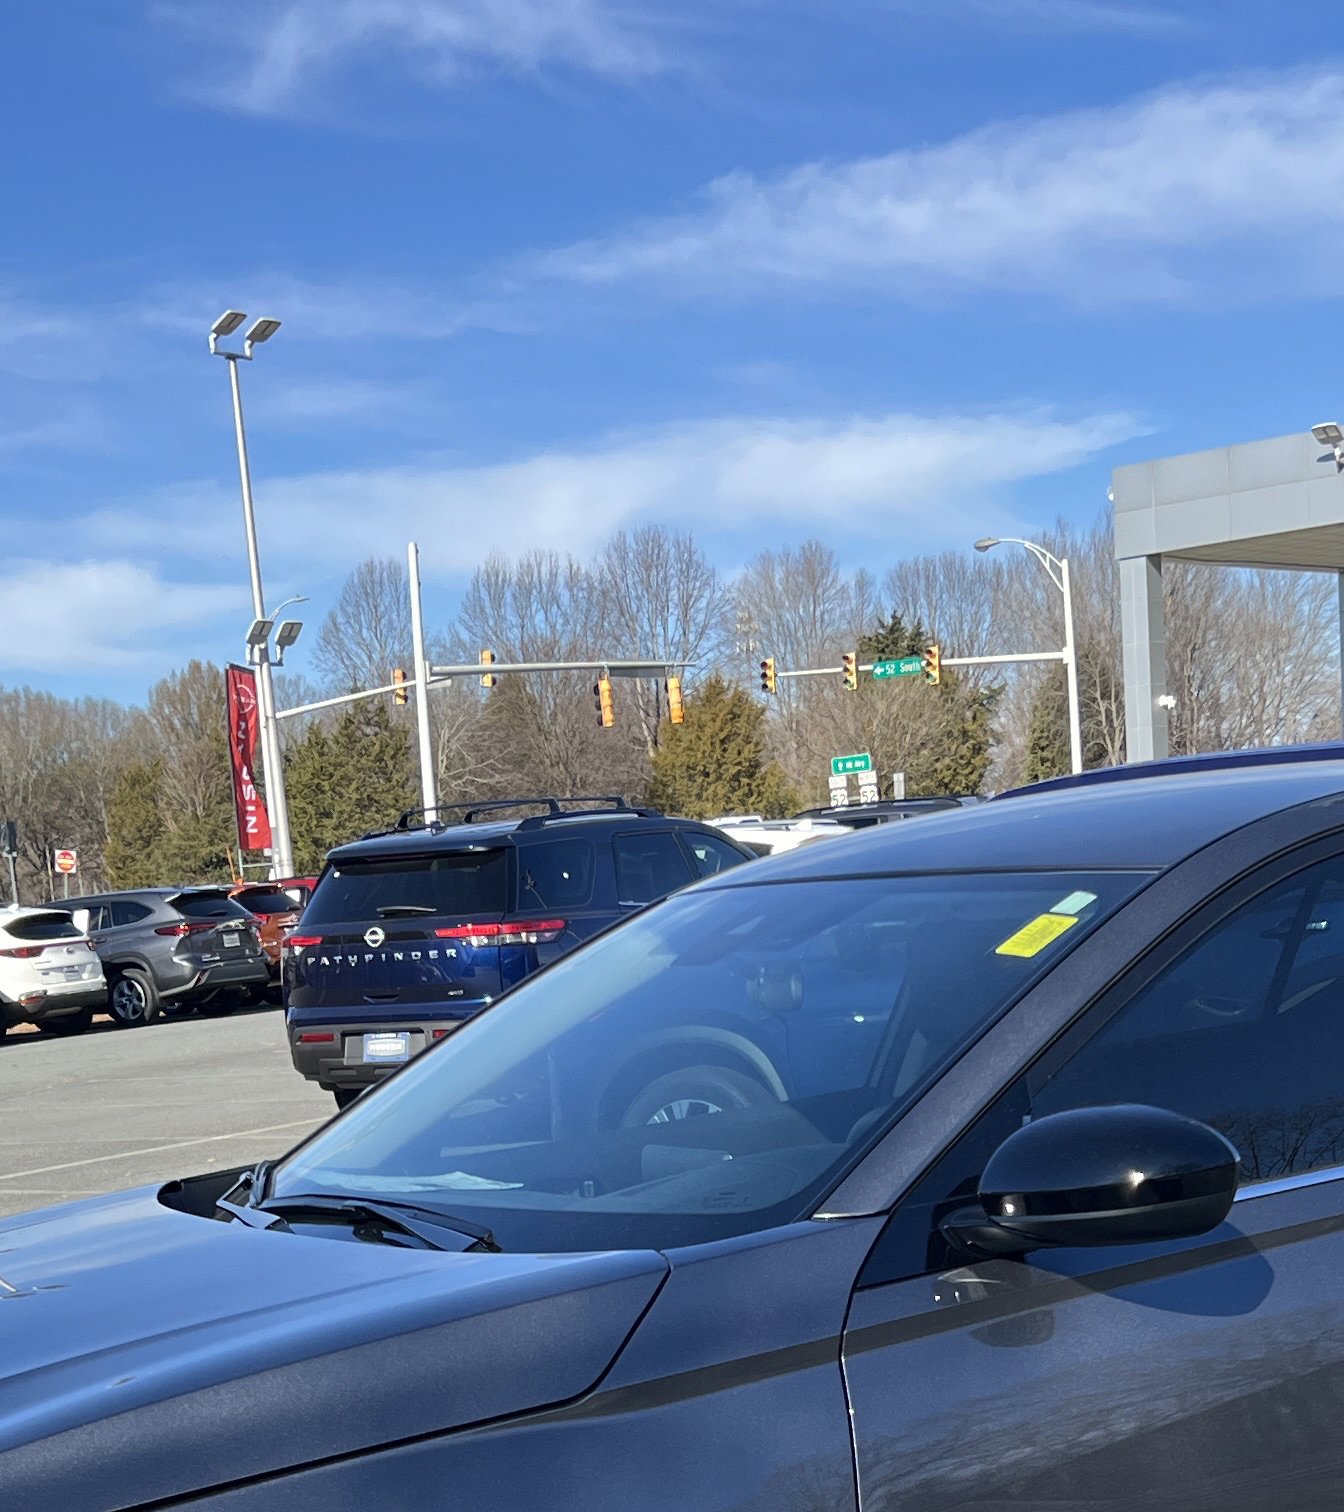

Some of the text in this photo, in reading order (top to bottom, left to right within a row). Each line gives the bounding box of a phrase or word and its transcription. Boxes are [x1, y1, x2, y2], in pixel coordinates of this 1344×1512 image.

[885, 663, 895, 675] 52
[861, 789, 876, 802] 52
[307, 949, 457, 966] PATHFINDER
